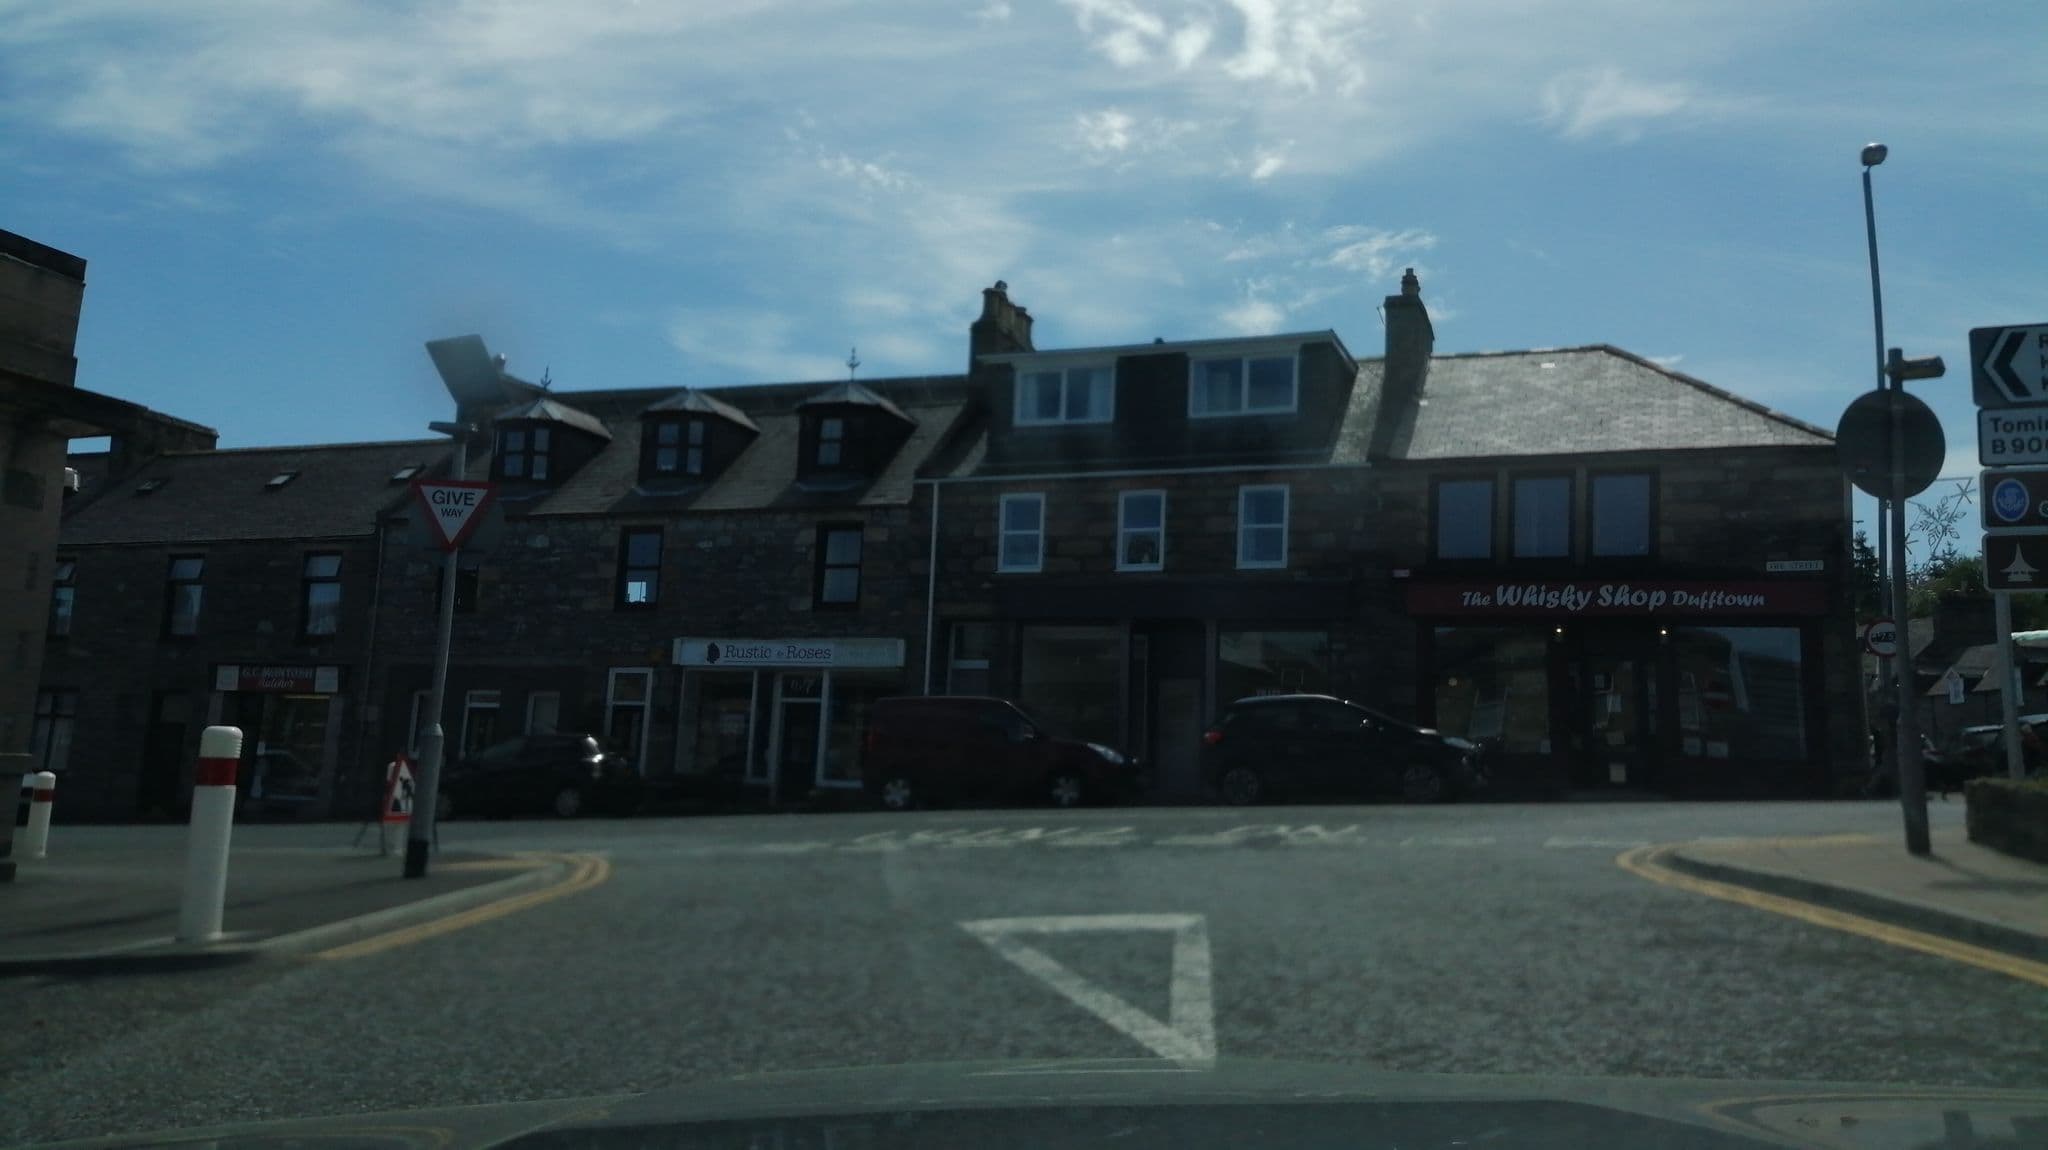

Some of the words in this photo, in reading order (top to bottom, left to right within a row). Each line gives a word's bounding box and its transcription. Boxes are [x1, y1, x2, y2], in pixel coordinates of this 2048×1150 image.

[1992, 438, 2048, 454] B90
[432, 489, 475, 506] GIVE
[441, 508, 463, 517] WAY
[1462, 592, 1491, 607] The
[1496, 584, 1593, 611] Whisky
[1597, 584, 1667, 611] Shop
[1672, 590, 1767, 608] Dufftown
[724, 645, 770, 659] Rustic
[787, 645, 832, 659] Roses
